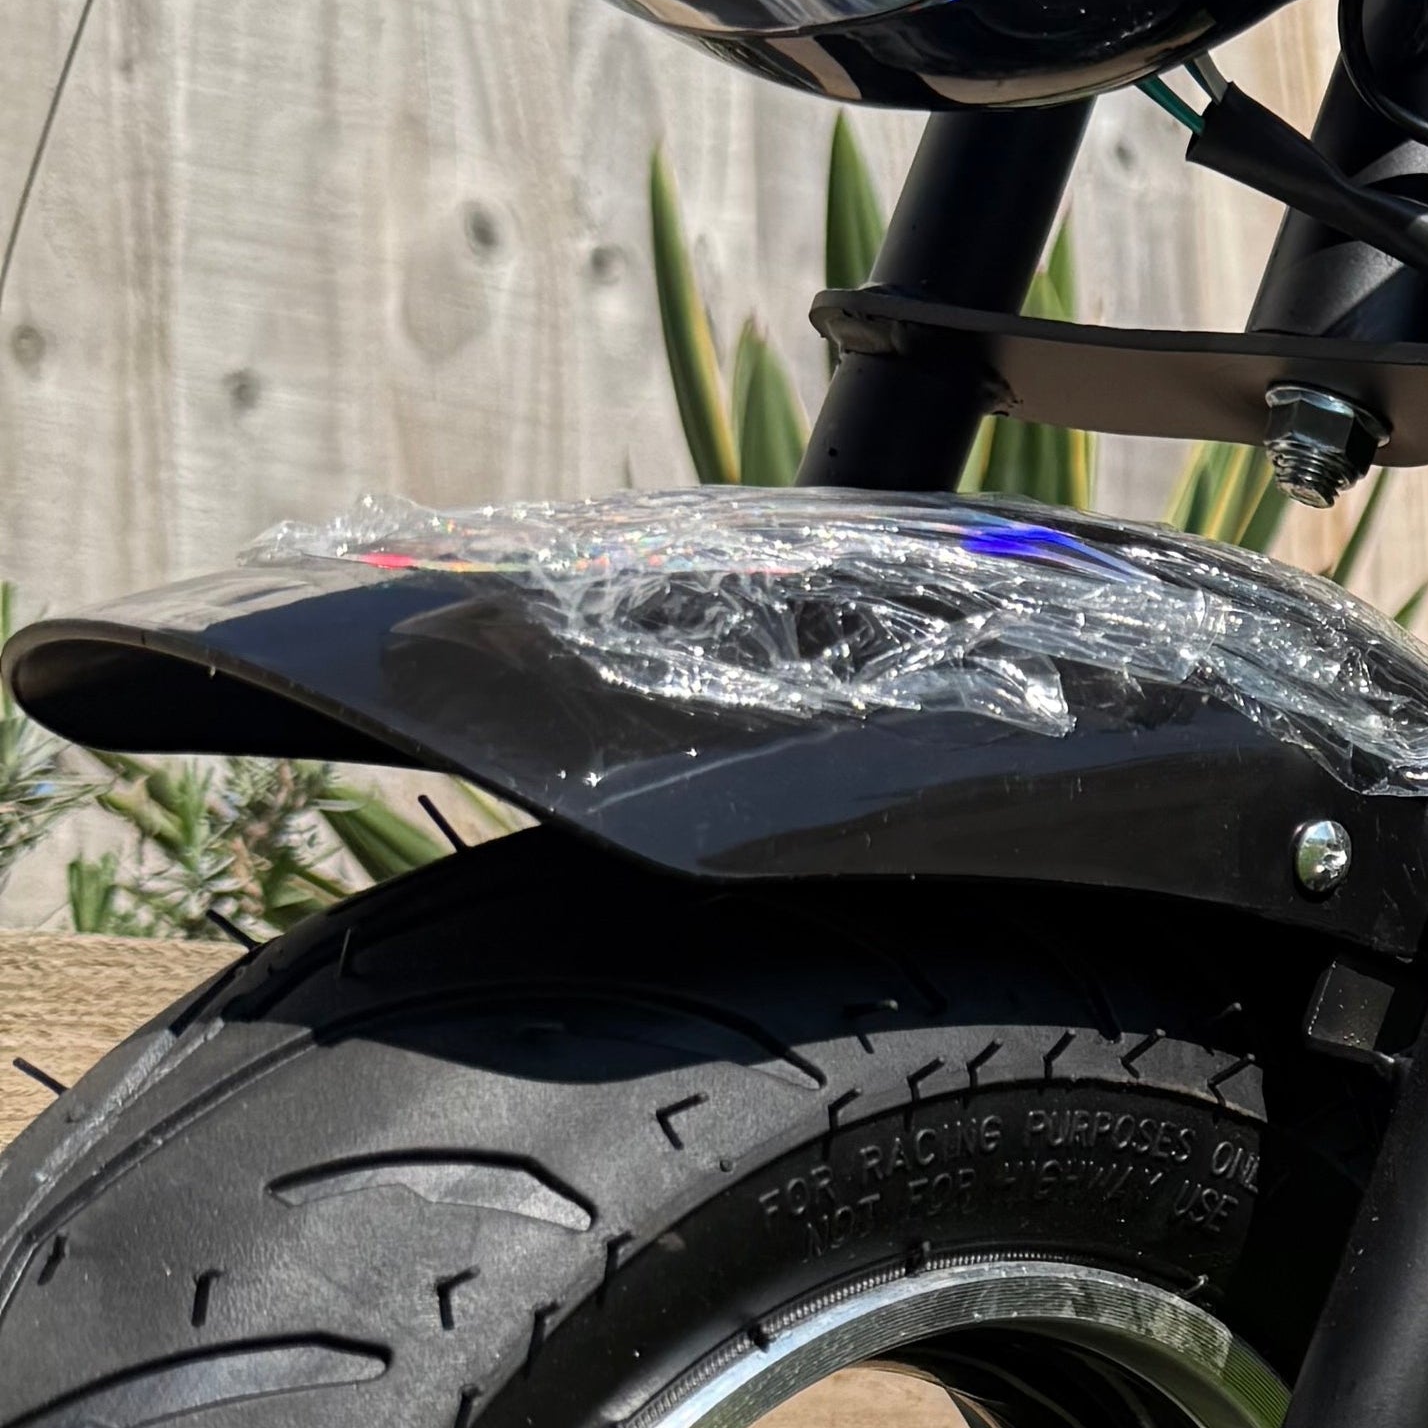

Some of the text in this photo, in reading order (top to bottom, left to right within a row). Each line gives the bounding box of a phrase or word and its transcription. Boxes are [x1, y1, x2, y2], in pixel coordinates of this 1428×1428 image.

[758, 1109, 1260, 1234] FOR RACING PURPOSES ONL
[803, 1192, 881, 1263] NOT
[907, 1169, 978, 1218] FOR
[1173, 1177, 1240, 1233] USE
